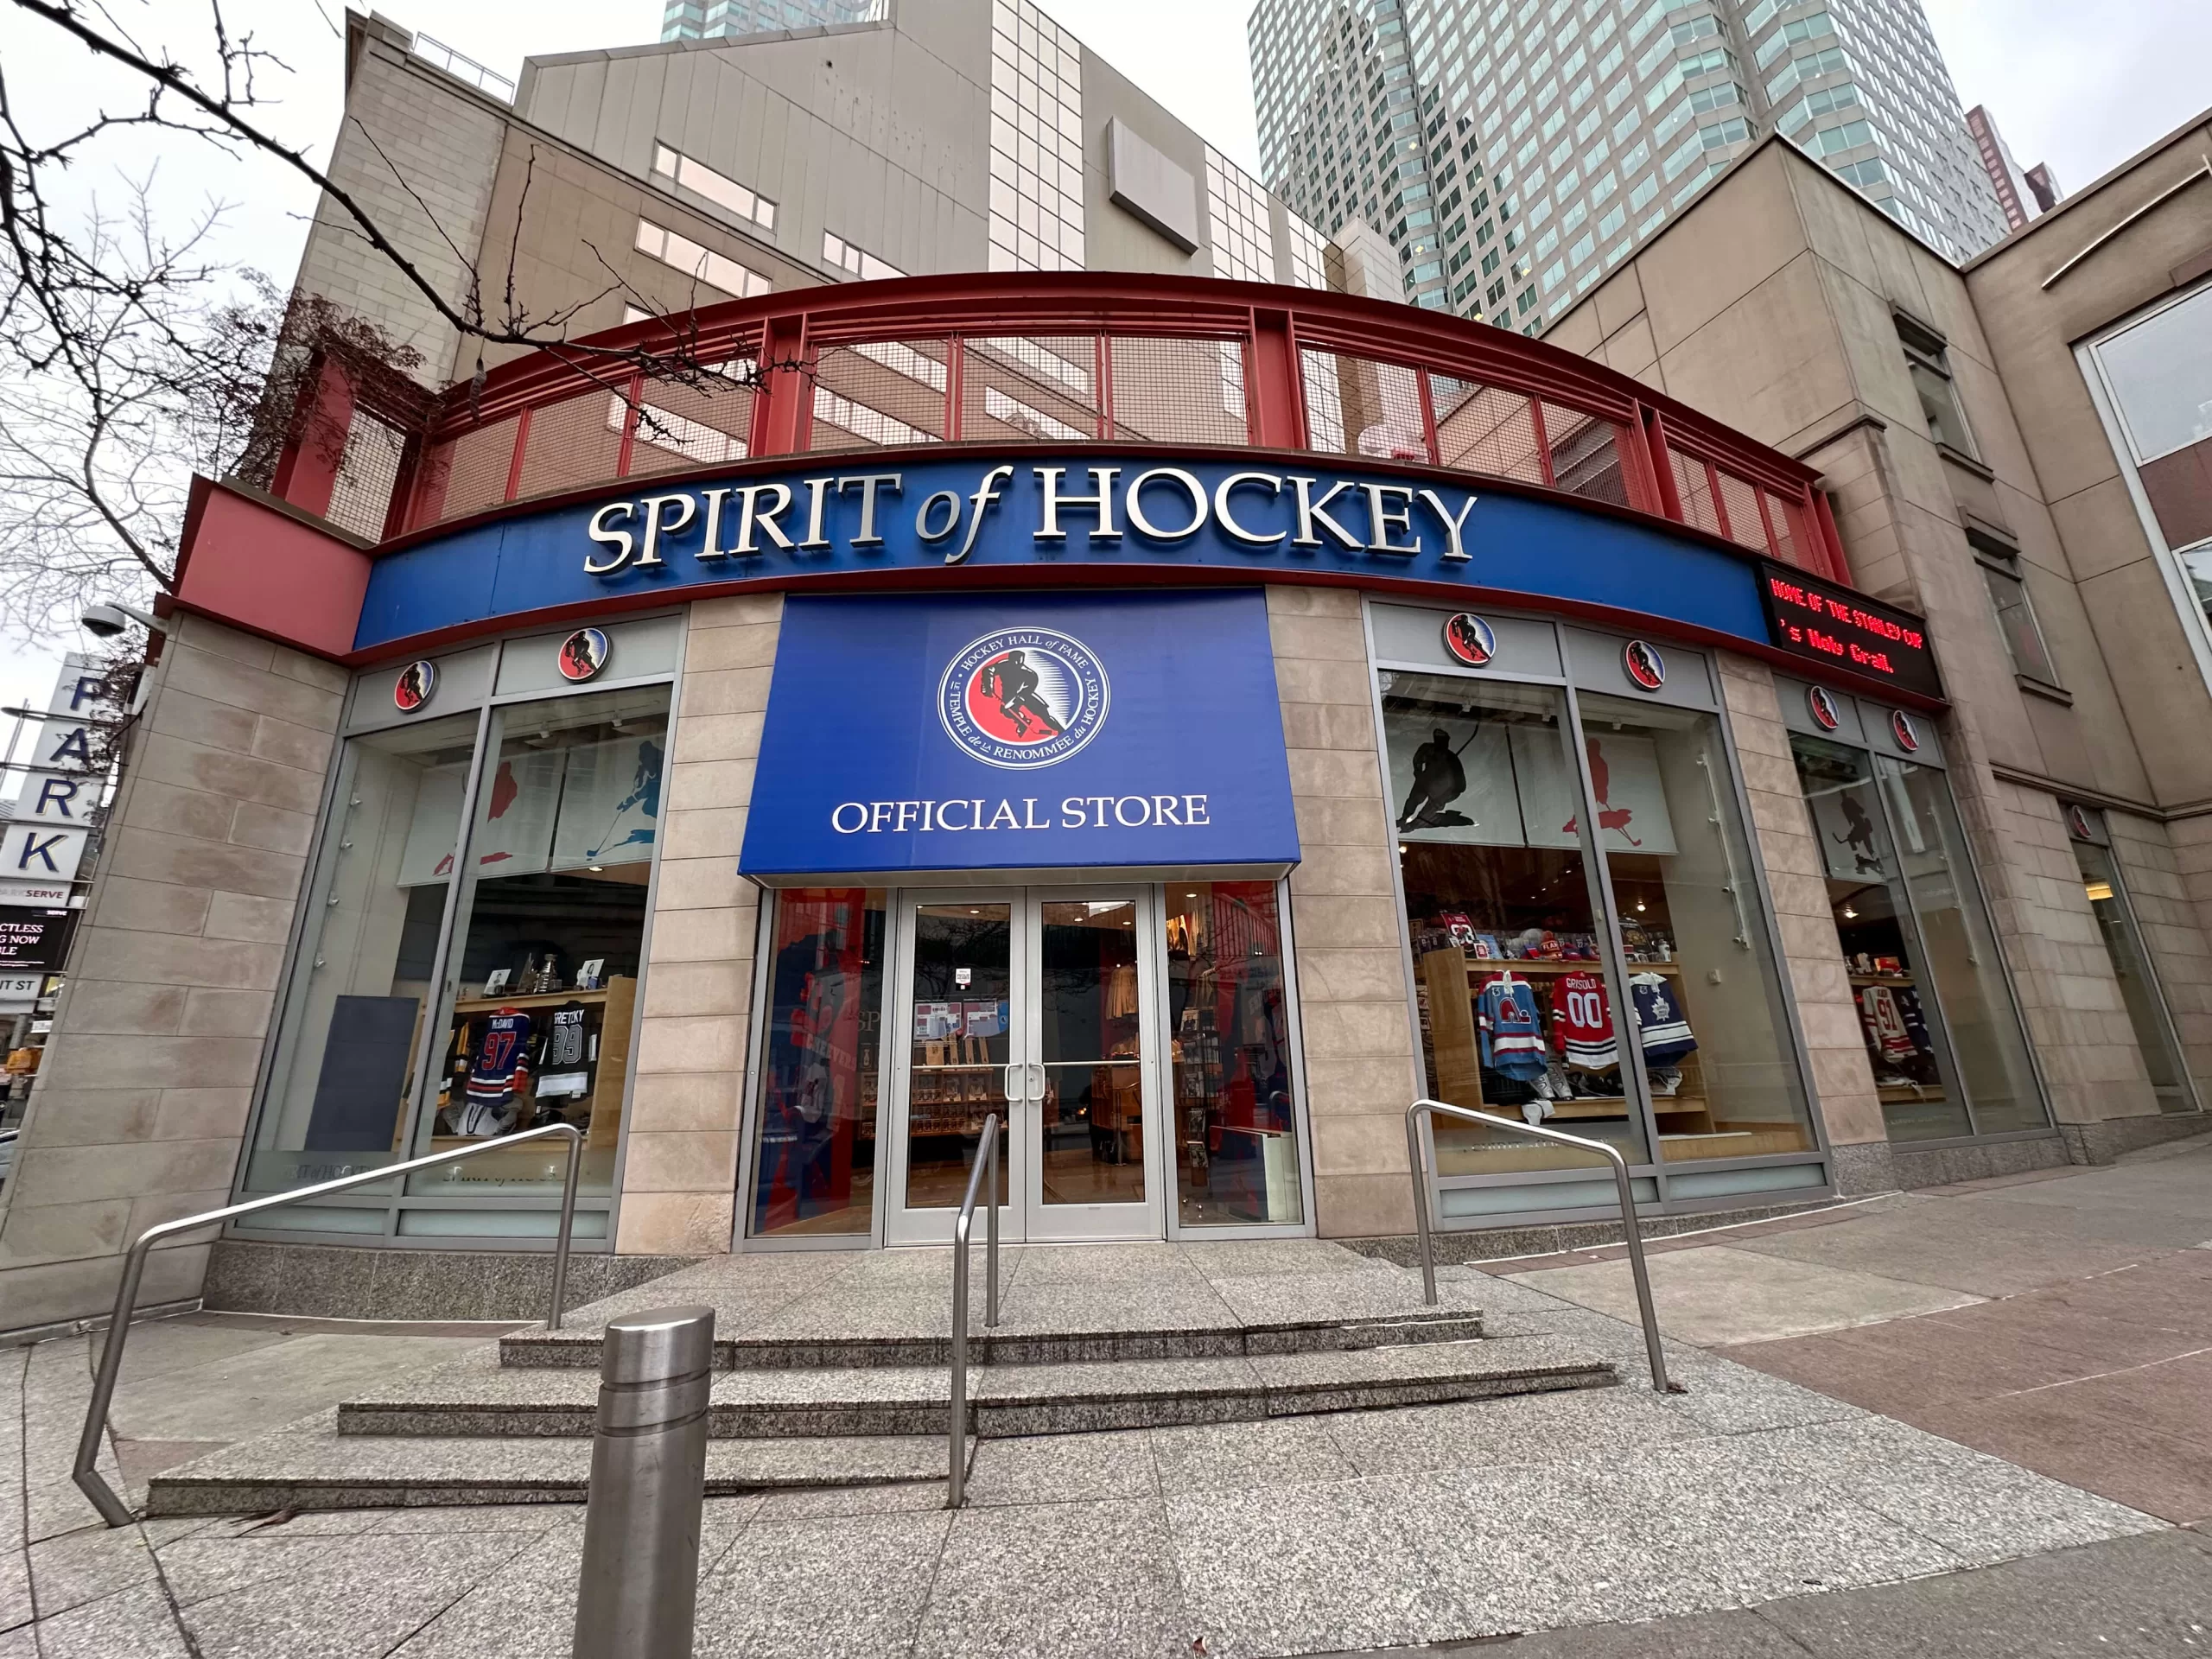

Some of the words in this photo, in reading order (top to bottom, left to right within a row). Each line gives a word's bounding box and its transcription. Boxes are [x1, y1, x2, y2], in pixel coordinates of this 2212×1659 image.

[583, 473, 902, 576] SPIRIT
[915, 465, 1014, 566] of
[1033, 467, 1478, 563] HOCKEY
[1770, 578, 1807, 607] HOME
[1808, 593, 1822, 612] OF
[1826, 599, 1852, 624] THE
[1853, 609, 1901, 641] STANLEY
[961, 639, 1004, 671] HOCKEY
[1007, 635, 1043, 645] HALL
[1045, 640, 1059, 651] of
[1058, 644, 1089, 670] FAME
[950, 691, 973, 737] TEMPLE
[968, 735, 982, 747] de
[993, 735, 1075, 760] RENOMMÉE
[1074, 727, 1086, 739] du
[1082, 677, 1099, 726] HOCKEY
[831, 798, 1051, 834] OFFICIAL
[1061, 794, 1211, 830] STORE
[9, 935, 41, 944] NOW
[16, 980, 35, 990] ST
[1567, 991, 1603, 1028] 00
[1877, 999, 1897, 1031] 91
[481, 1031, 517, 1070] 97
[552, 1024, 583, 1065] 99
